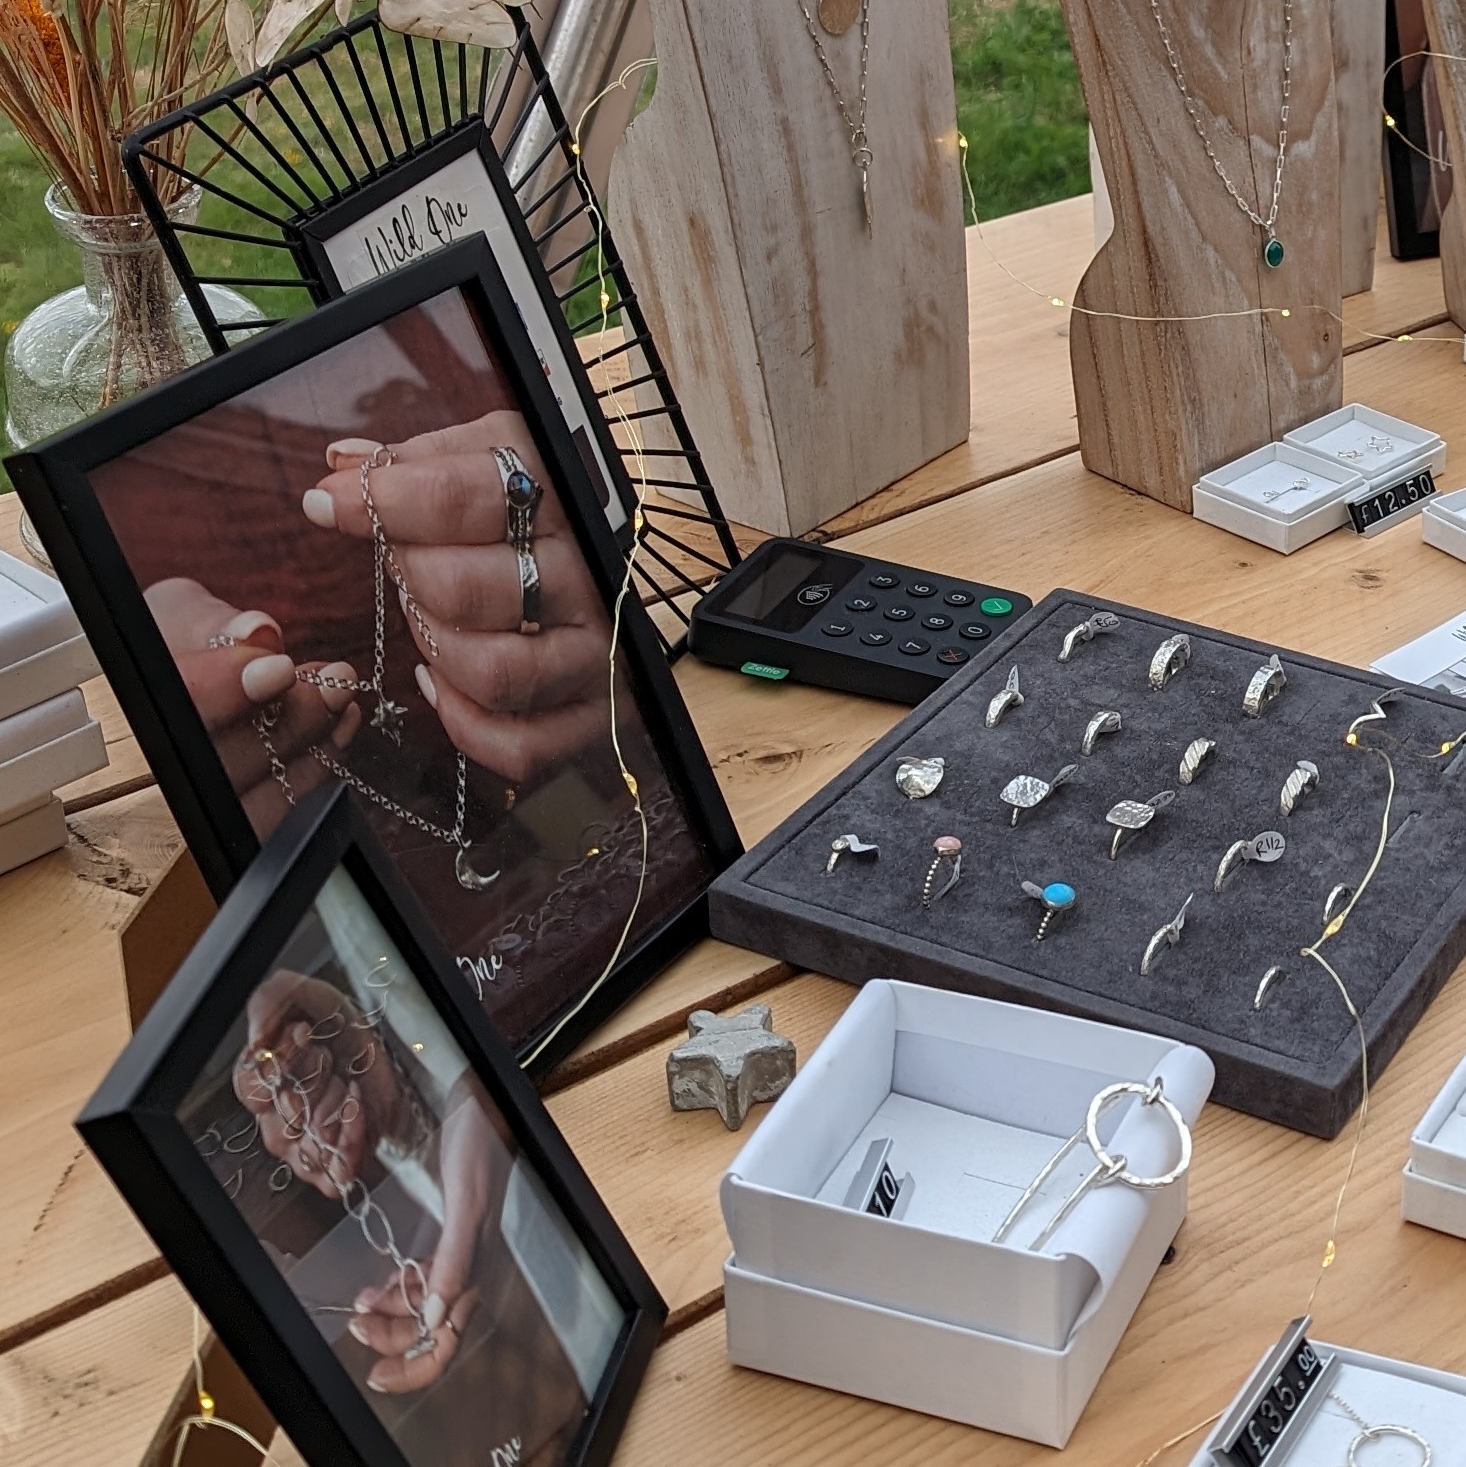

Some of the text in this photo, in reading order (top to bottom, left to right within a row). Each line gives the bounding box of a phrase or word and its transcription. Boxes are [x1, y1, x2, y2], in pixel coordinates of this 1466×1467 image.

[1361, 473, 1432, 524] £12.50
[877, 574, 893, 585] 3
[913, 583, 930, 594] 6
[853, 598, 871, 608] 2
[951, 593, 967, 603] 9
[891, 607, 907, 618] 5
[929, 616, 945, 627] 8
[830, 622, 846, 633] 1
[967, 625, 983, 636] 0
[868, 631, 884, 642] 4
[905, 640, 922, 651] 7
[1255, 836, 1285, 858] R112
[1248, 1344, 1319, 1458] £35.00
